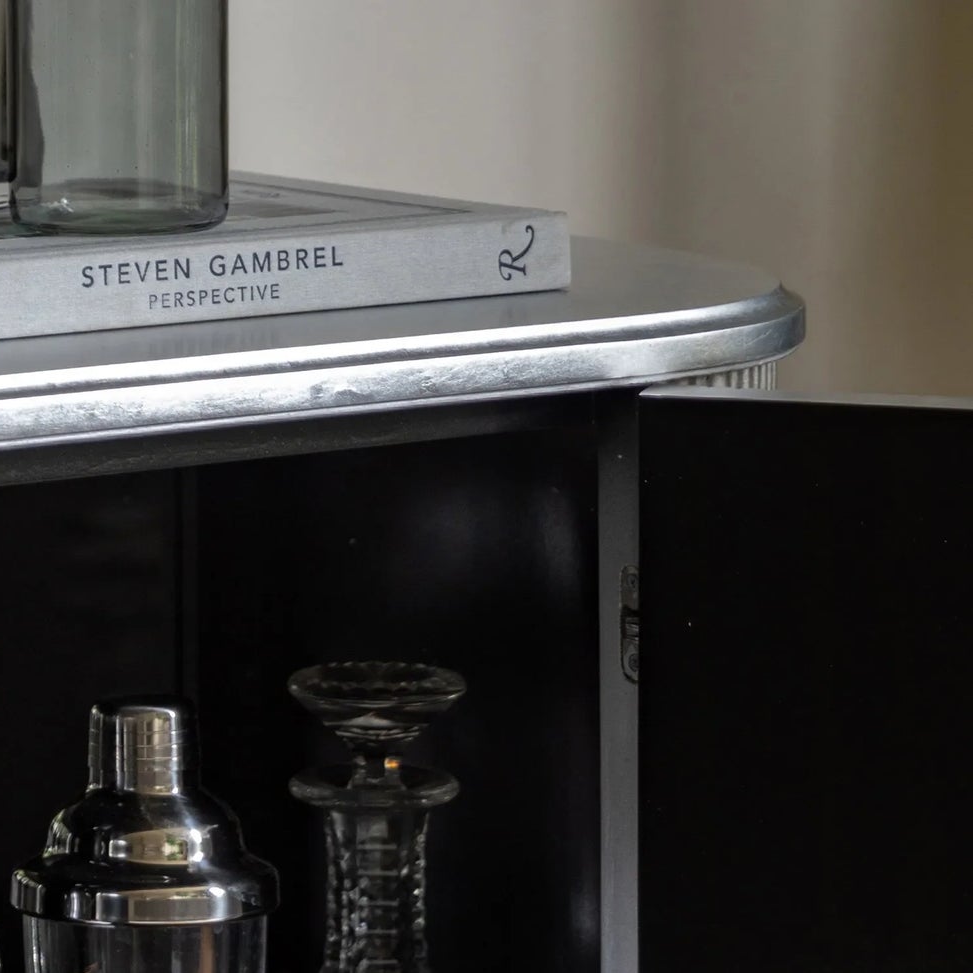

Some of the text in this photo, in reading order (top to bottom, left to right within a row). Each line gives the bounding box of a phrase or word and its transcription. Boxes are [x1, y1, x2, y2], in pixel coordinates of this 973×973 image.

[81, 245, 344, 288] STEVEN GAMBREL
[148, 283, 281, 310] PERSPECTIVE
